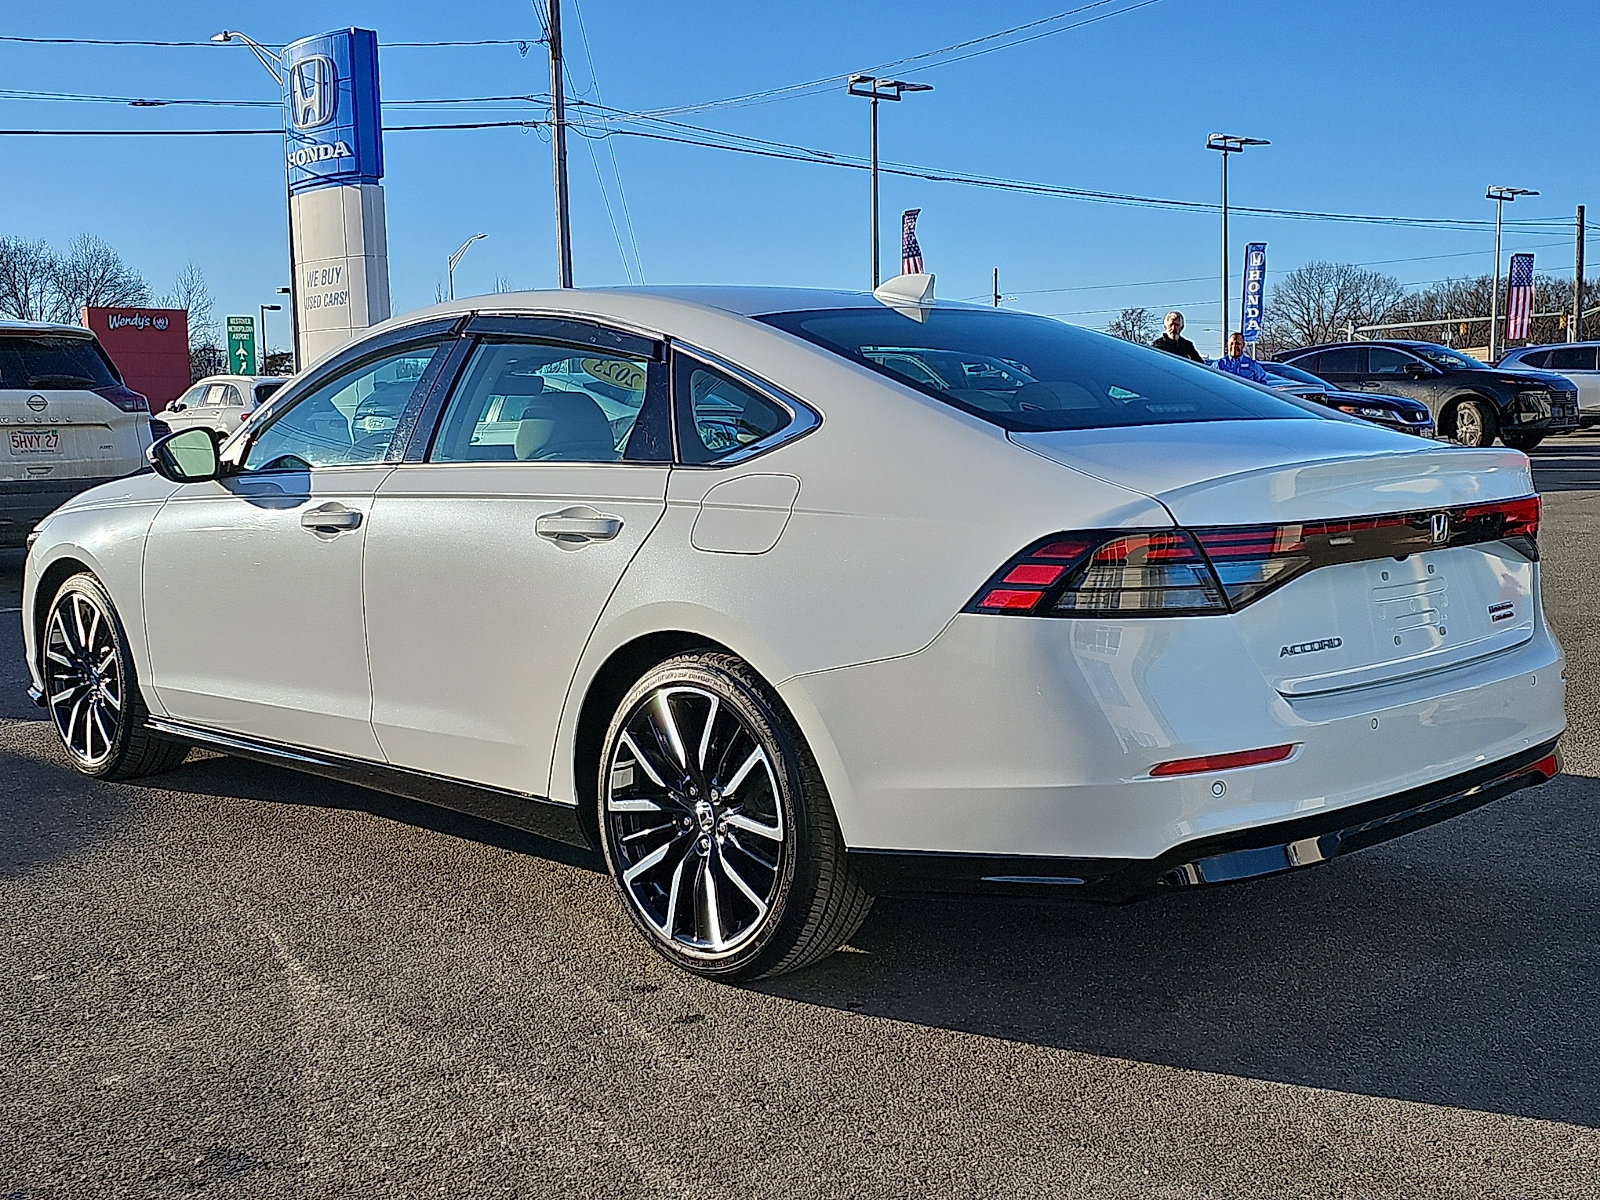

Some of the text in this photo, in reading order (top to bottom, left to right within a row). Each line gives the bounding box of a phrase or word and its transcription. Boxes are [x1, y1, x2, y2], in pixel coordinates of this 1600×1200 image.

[287, 141, 351, 168] HONDA
[306, 266, 342, 288] WE BUY
[305, 290, 348, 310] USED CARS!
[1246, 270, 1262, 331] HONDA
[109, 313, 150, 329] Wendy's
[11, 434, 59, 449] 5HVY 27
[1280, 637, 1343, 657] ACCORD
